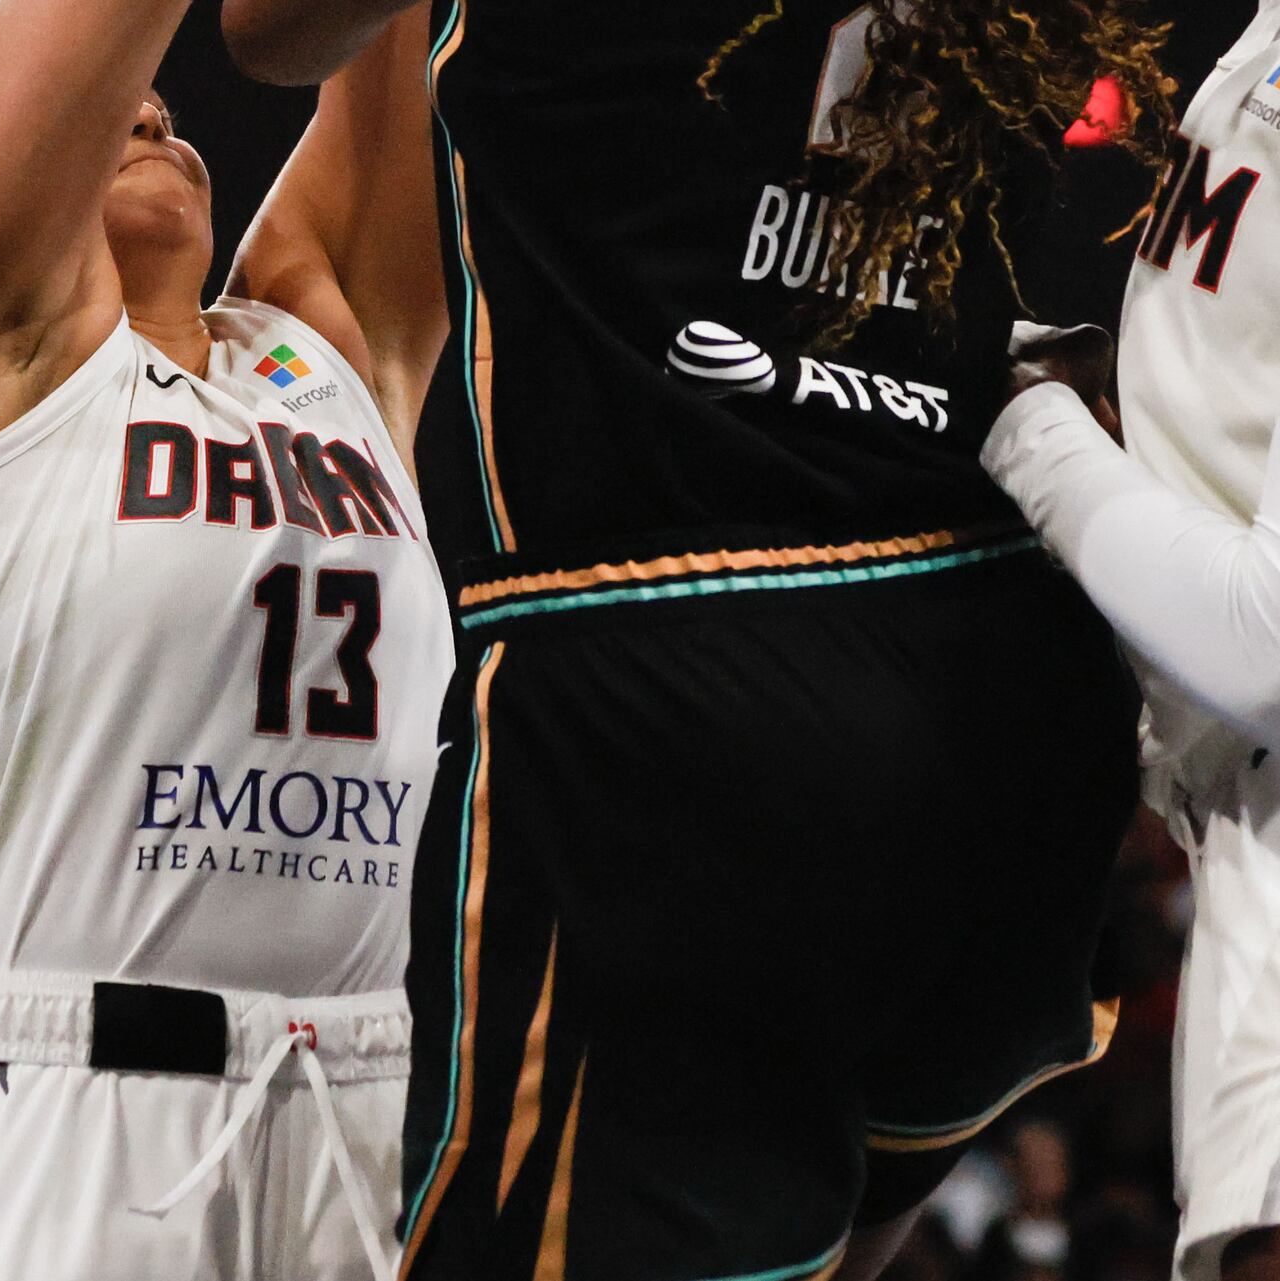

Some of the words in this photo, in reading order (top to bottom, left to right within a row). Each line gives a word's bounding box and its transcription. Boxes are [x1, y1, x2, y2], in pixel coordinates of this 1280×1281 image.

[792, 357, 949, 432] AT&T
[253, 563, 381, 741] 13
[136, 763, 412, 847] EMORY
[136, 844, 401, 889] HEALTHCARE
